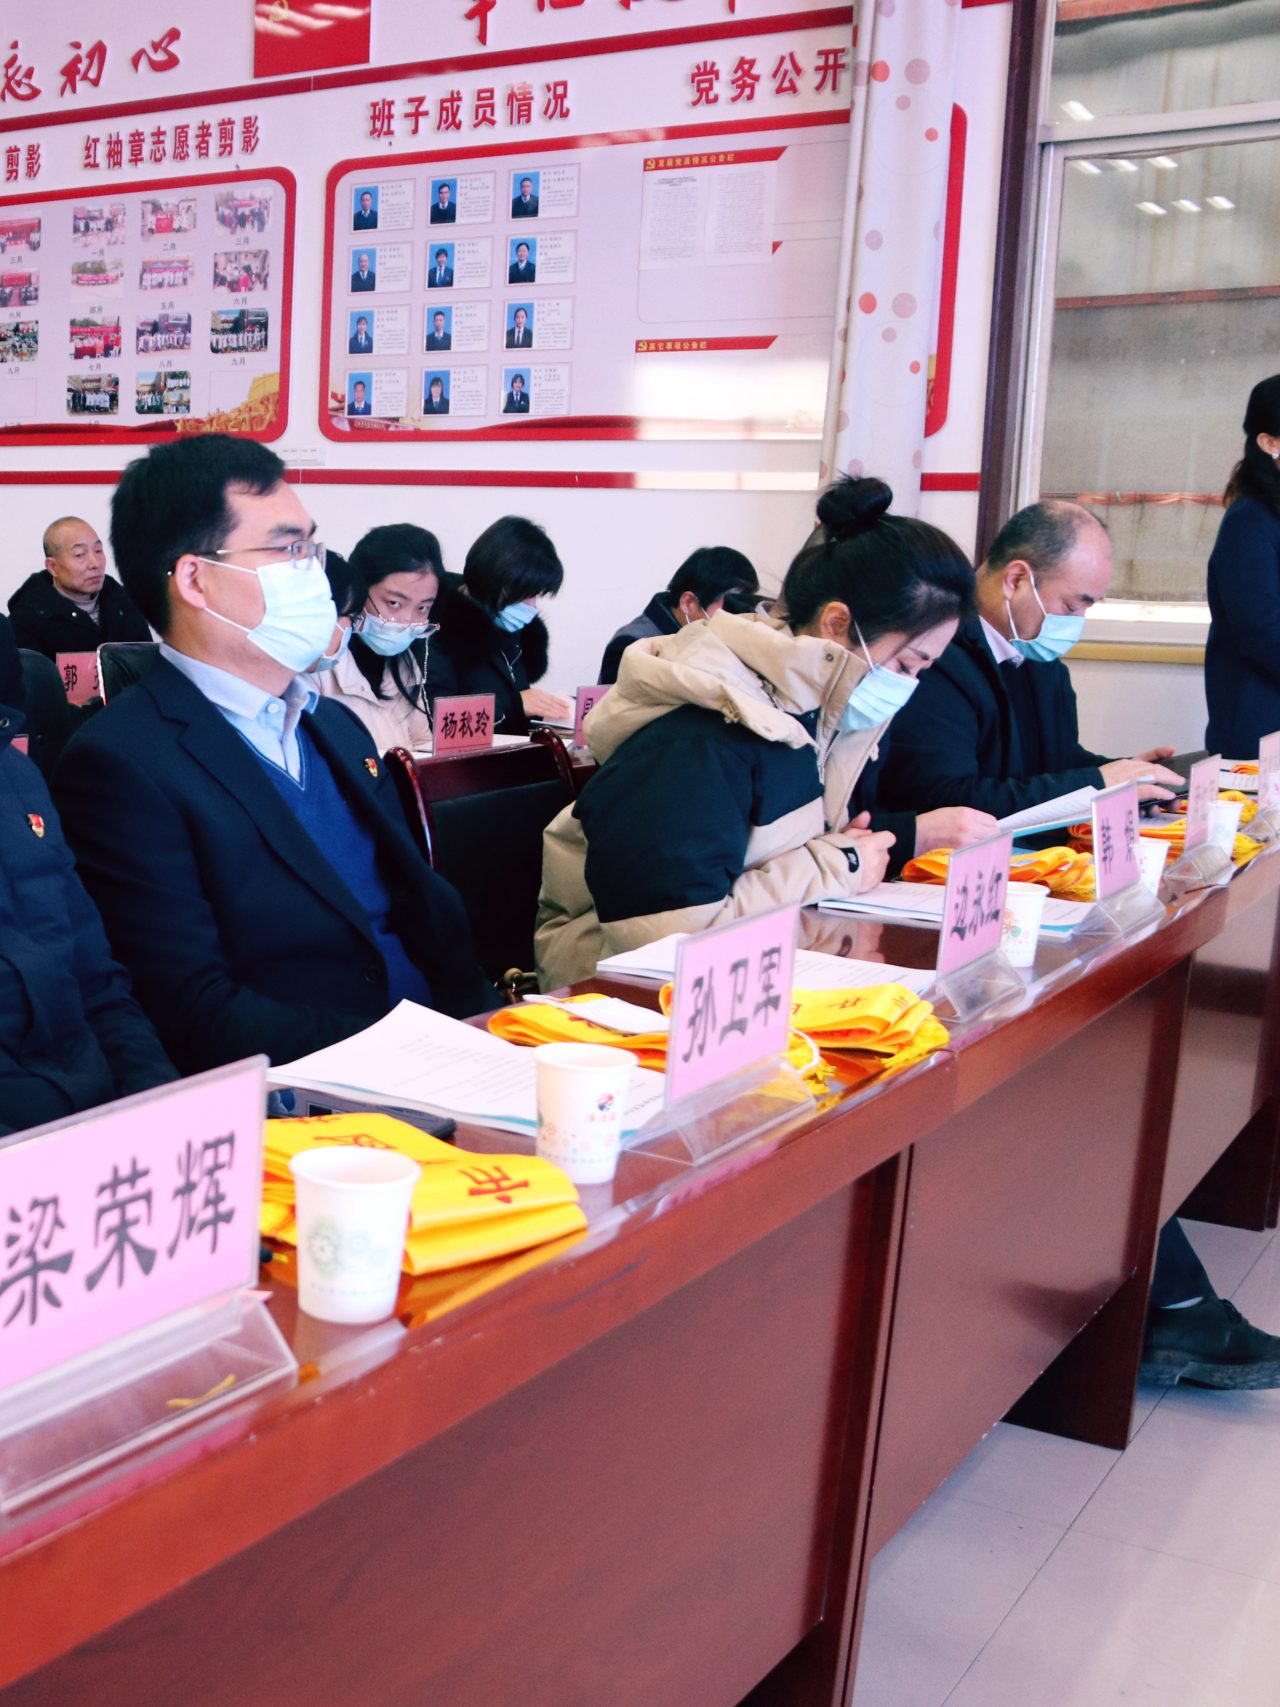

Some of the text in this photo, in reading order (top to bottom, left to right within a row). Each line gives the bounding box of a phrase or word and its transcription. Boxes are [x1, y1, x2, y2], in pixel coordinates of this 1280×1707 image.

[690, 47, 847, 108] 党务公开
[369, 80, 570, 139] 班子成员情况
[83, 115, 260, 170] 红袖章志愿者剪影
[235, 237, 250, 246] 三月
[163, 243, 176, 252] 二月
[10, 256, 23, 264] 三月
[160, 302, 174, 310] 五月
[233, 297, 248, 306] 六月
[89, 306, 103, 314] 四月
[9, 311, 21, 319] 六月
[158, 360, 173, 368] 八月
[231, 358, 246, 366] 九月
[8, 367, 20, 375] 九月
[88, 363, 102, 371] 七月
[64, 664, 99, 692] 郭
[441, 708, 490, 739] 杨秋玲
[682, 944, 782, 1063] 孙卫军
